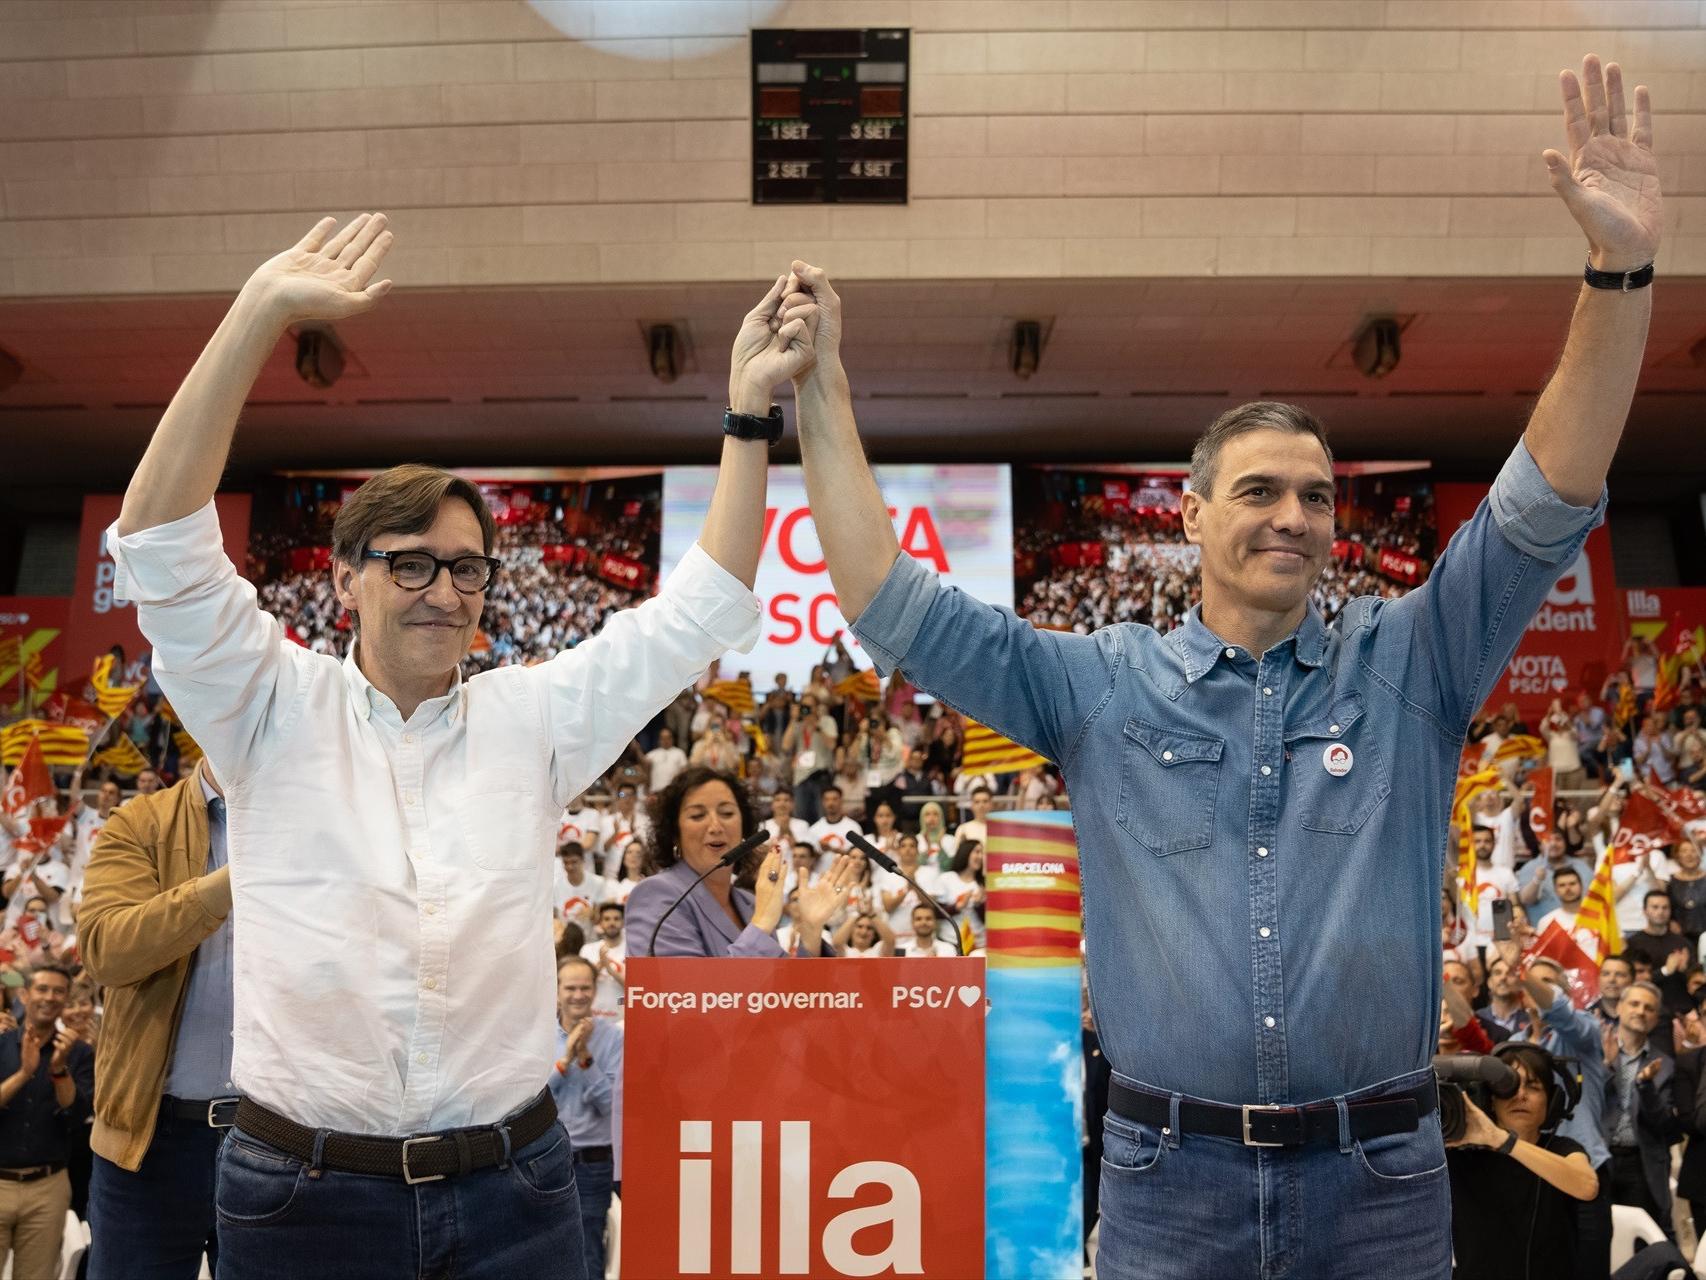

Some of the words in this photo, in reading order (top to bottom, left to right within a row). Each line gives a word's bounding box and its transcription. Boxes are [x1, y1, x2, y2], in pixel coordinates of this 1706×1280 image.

[771, 126, 779, 140] 1
[781, 124, 810, 140] SET
[850, 125, 861, 140] 3
[863, 124, 893, 140] SET
[768, 163, 780, 178] 2
[781, 163, 810, 178] SET
[850, 162, 861, 177] 4
[863, 162, 893, 177] SET
[1510, 655, 1566, 678] VOTA
[627, 986, 697, 1014] Força
[701, 990, 744, 1014] per
[747, 990, 864, 1014] governar.
[679, 1120, 925, 1277] illa
